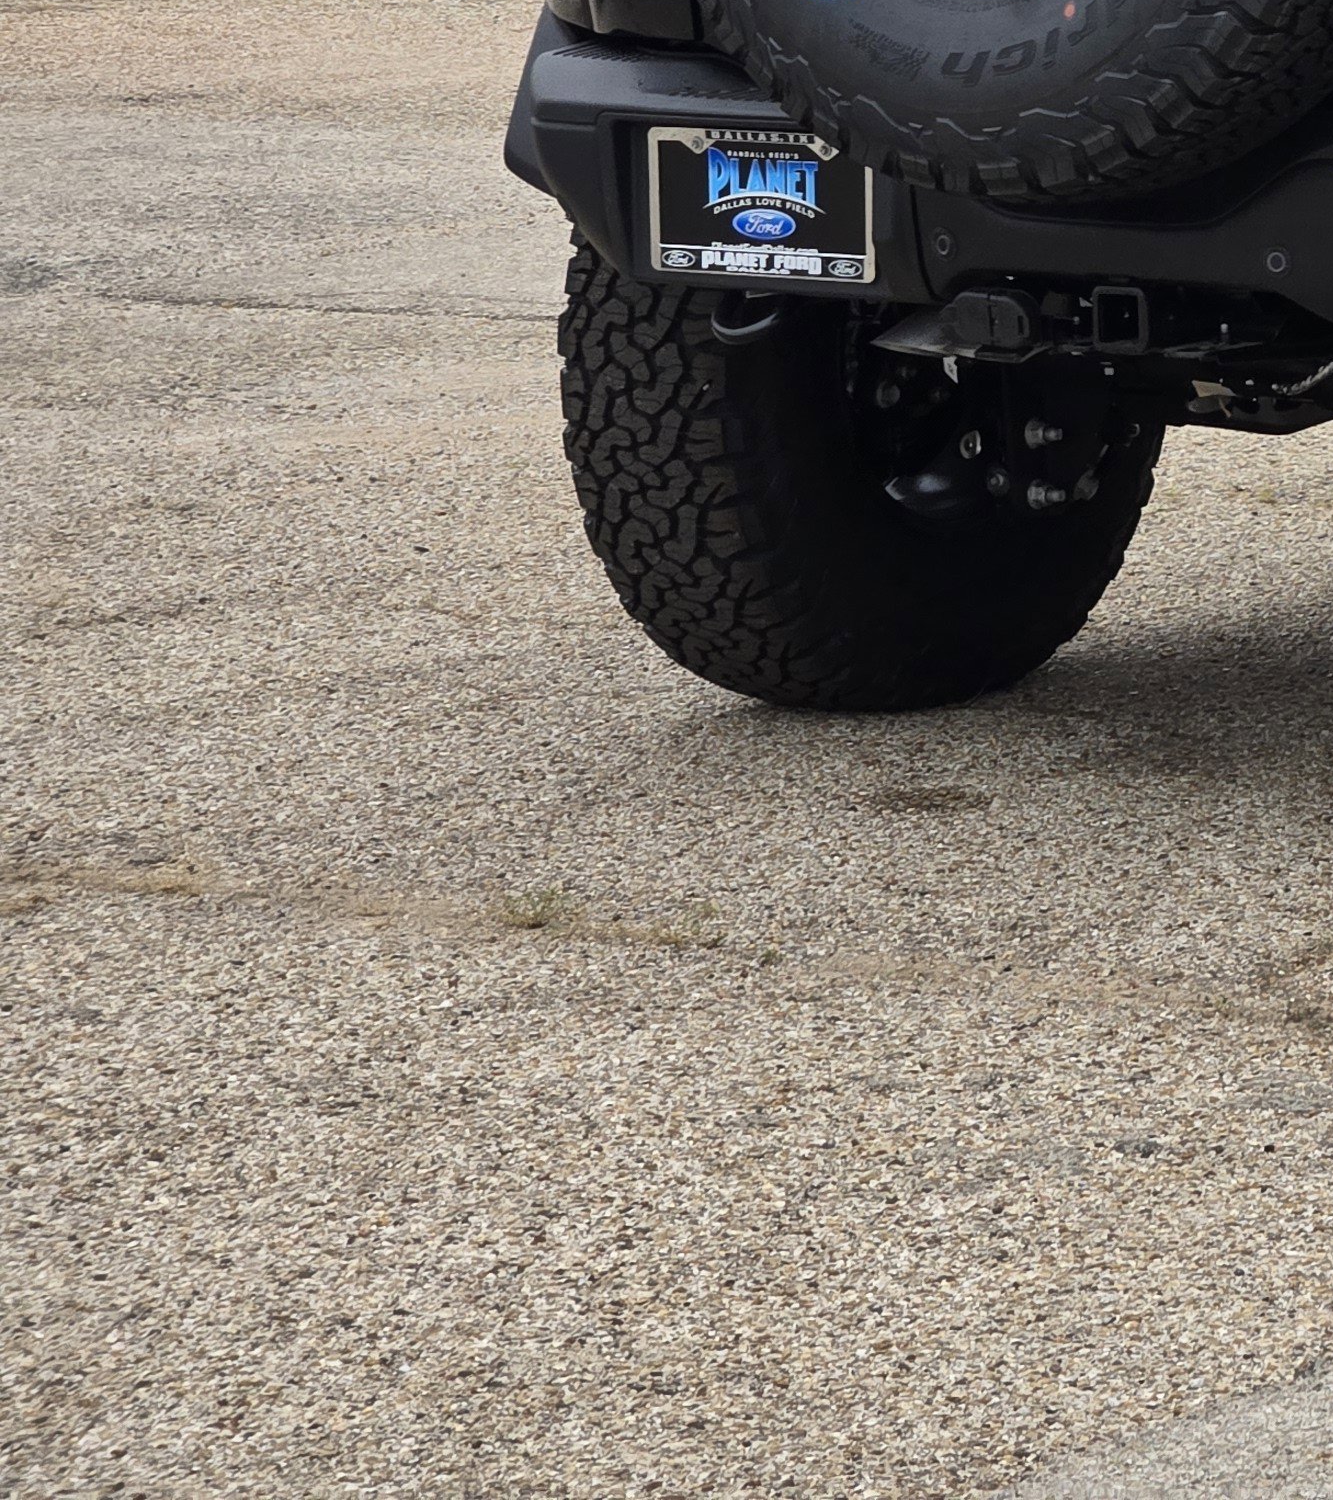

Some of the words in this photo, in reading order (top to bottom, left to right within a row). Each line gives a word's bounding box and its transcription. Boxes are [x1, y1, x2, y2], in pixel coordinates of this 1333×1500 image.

[708, 146, 818, 206] PLANET
[713, 198, 752, 214] DALLAS
[756, 198, 782, 207] LOVE
[786, 201, 815, 218] FIELD
[745, 212, 785, 235] Ford
[701, 250, 769, 269] PLANET
[774, 255, 822, 275] FORD
